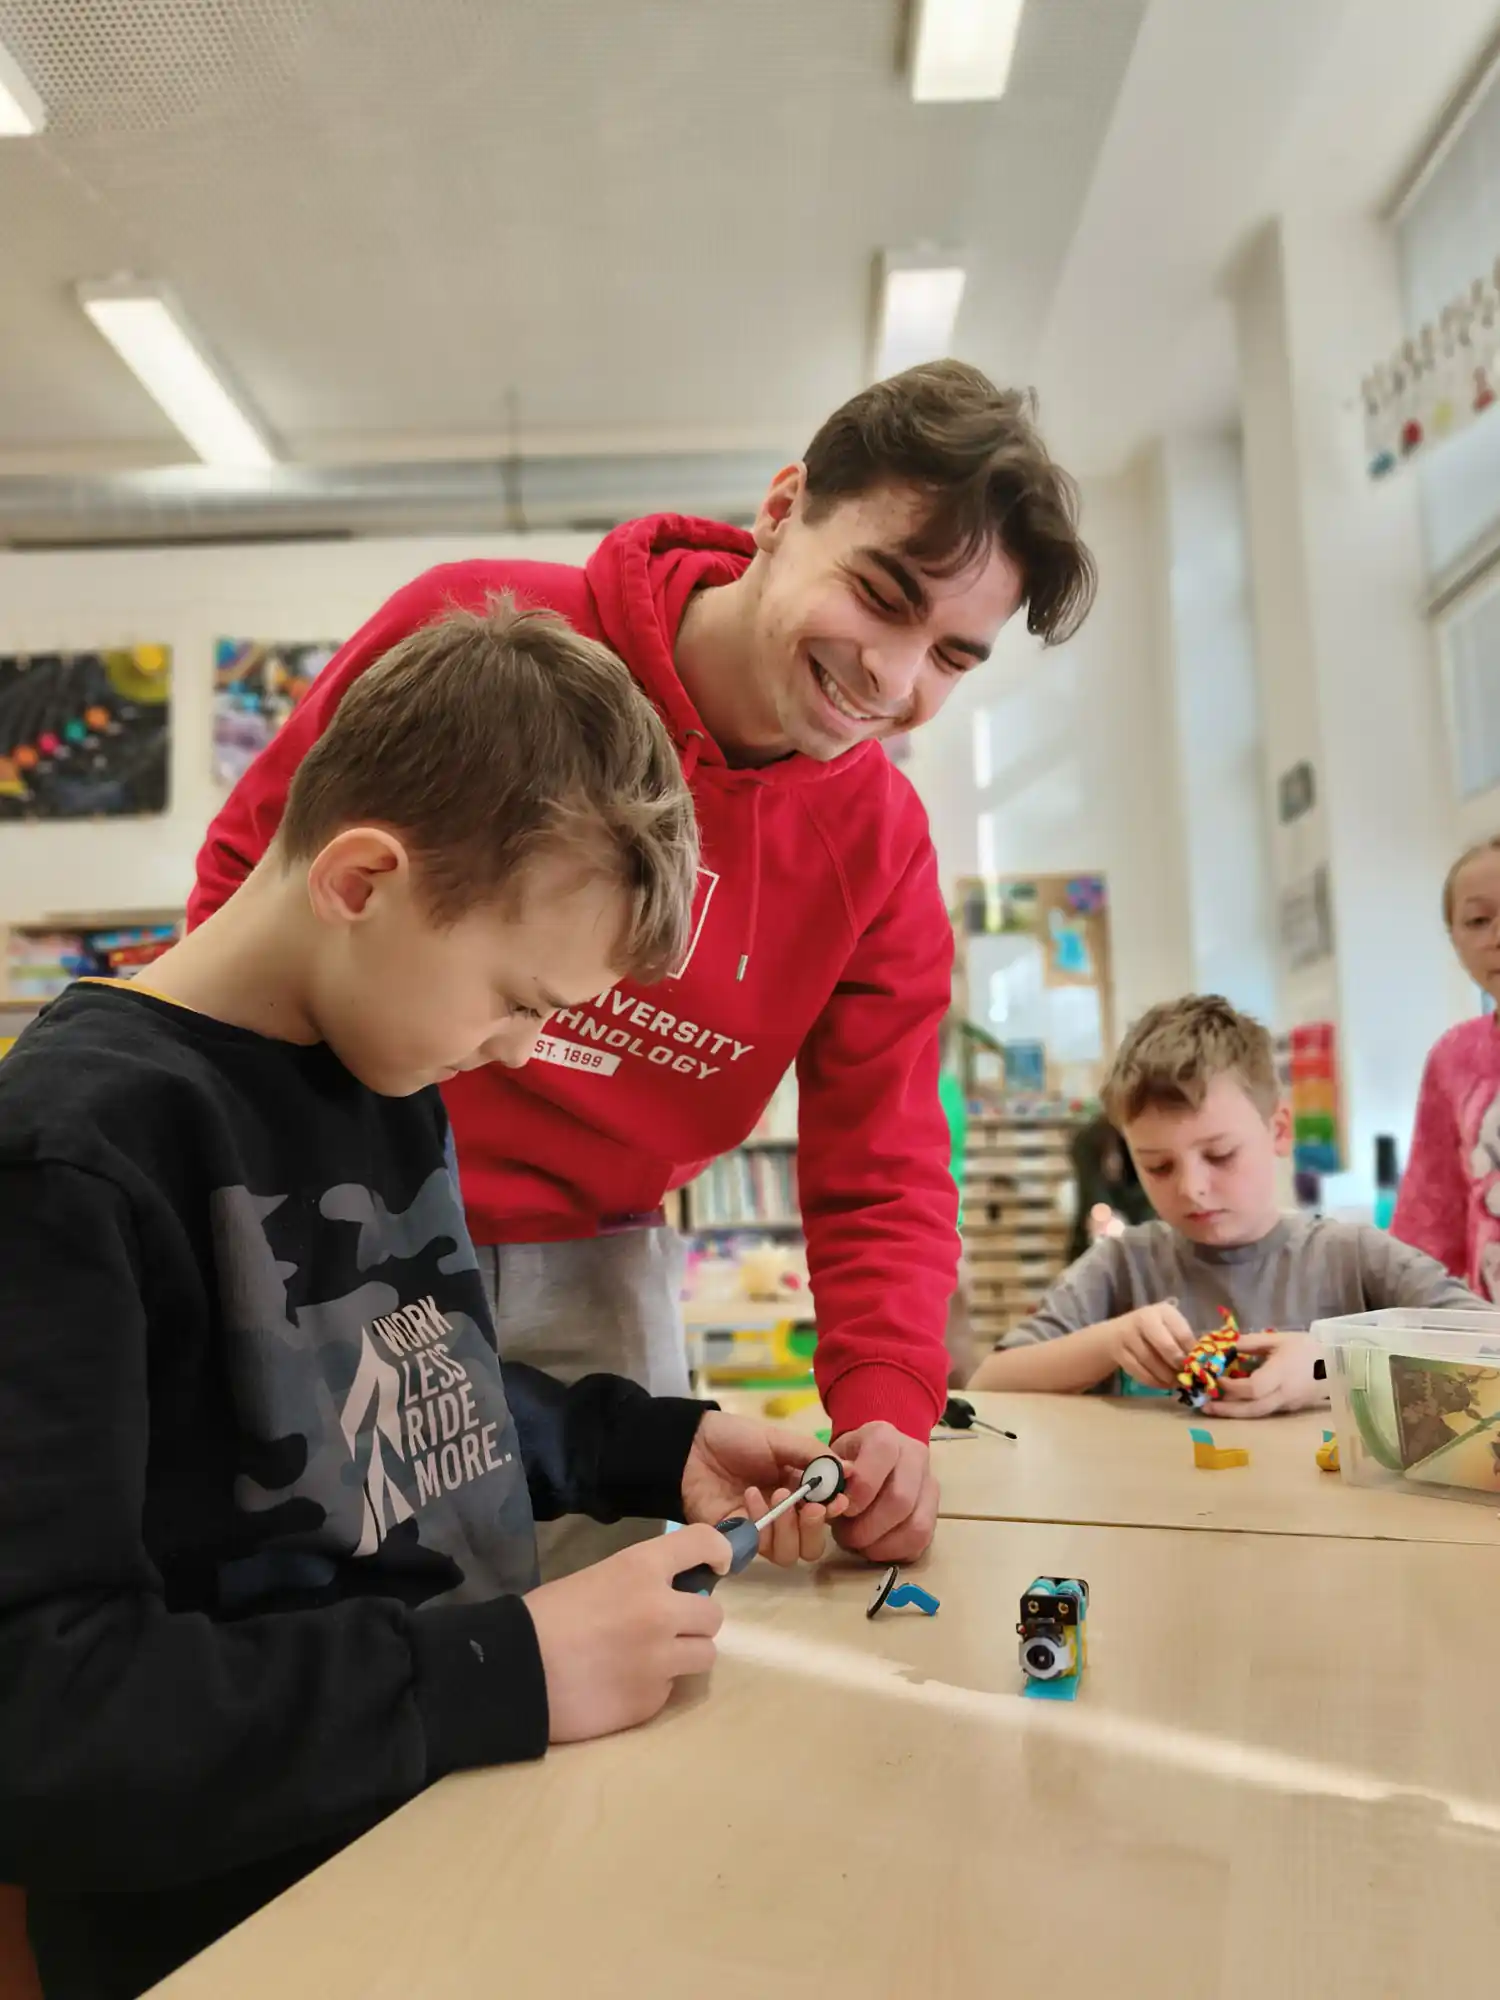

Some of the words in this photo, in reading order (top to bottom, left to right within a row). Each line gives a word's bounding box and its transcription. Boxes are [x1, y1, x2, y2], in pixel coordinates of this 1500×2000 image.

[534, 1039, 556, 1058] ST.
[564, 1047, 603, 1068] 1899
[556, 1008, 720, 1080] HNOLOGY
[594, 987, 755, 1062] IVERSITY
[373, 1295, 453, 1357] WORK
[402, 1343, 467, 1406] LESS
[405, 1382, 480, 1457] RIDE
[414, 1422, 512, 1507] MORE.
